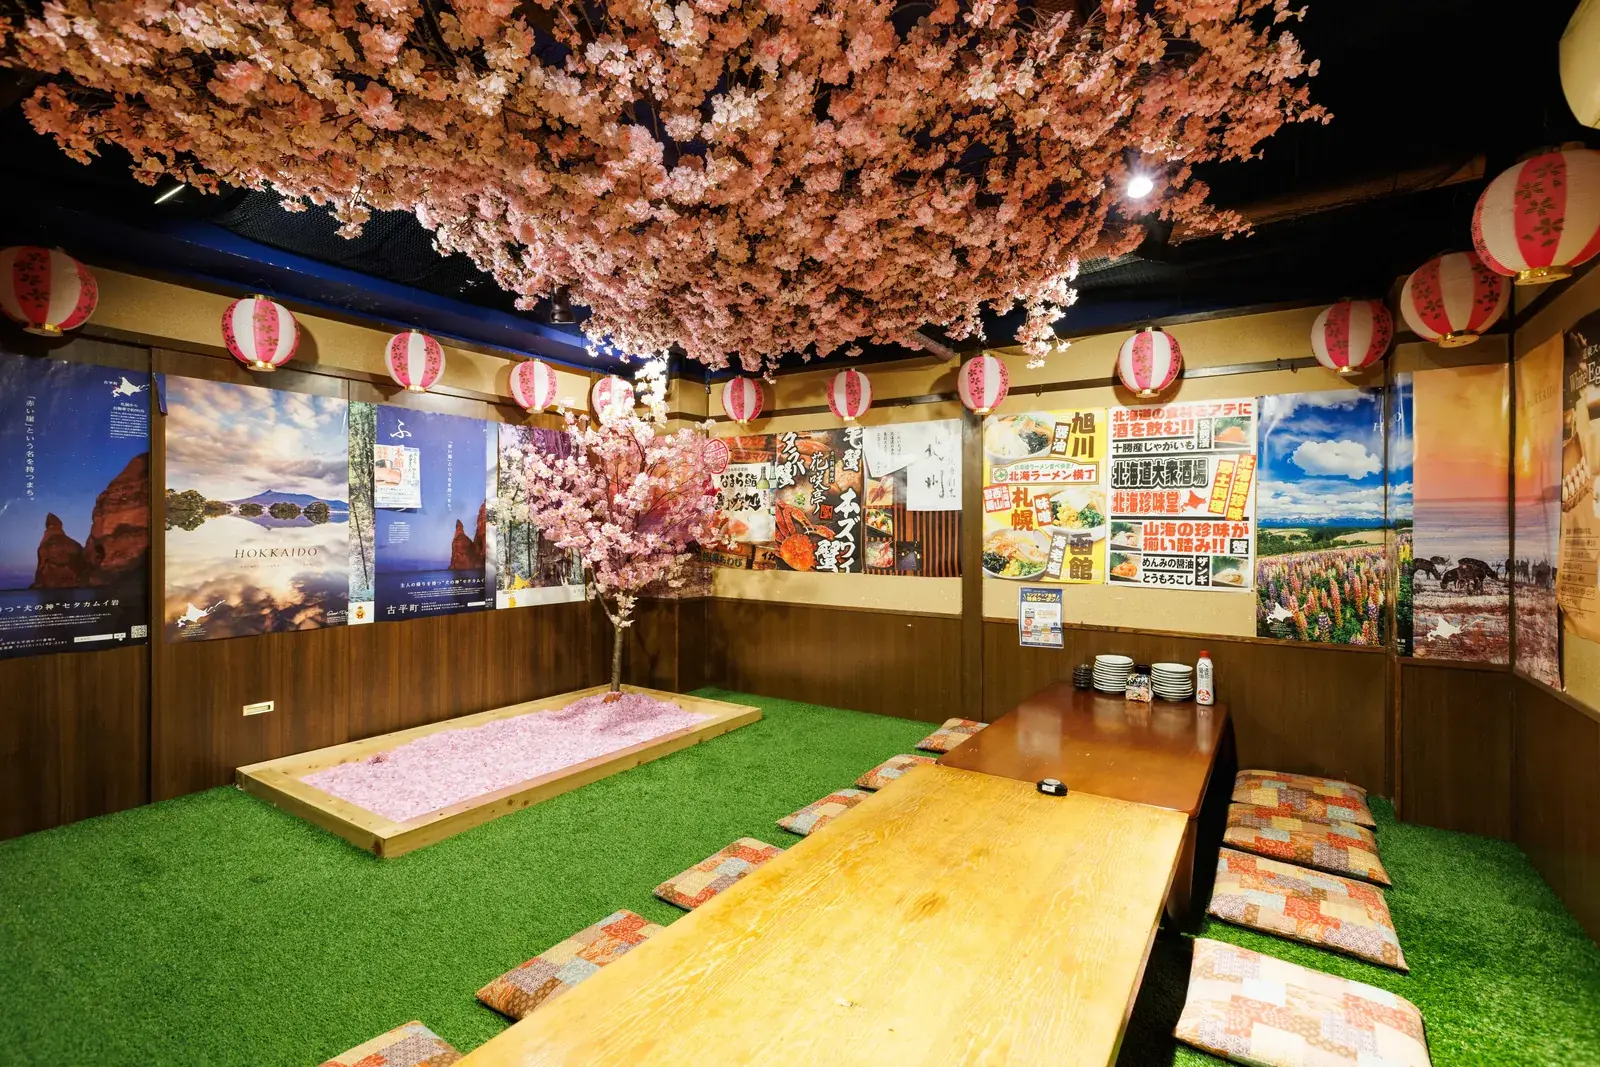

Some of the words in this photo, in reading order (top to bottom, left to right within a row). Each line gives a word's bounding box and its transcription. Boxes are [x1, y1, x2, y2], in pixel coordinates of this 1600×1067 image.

[1071, 412, 1096, 458] 旭川
[1113, 440, 1195, 453] 十勝産じゃがいも
[1009, 469, 1095, 481] 北海ラーメン横丁
[1112, 459, 1208, 487] 北海道大衆酒場
[1011, 487, 1034, 531] 札幌
[1112, 491, 1180, 514] 北海珍味堂
[1143, 522, 1249, 538] 山海の珍味が
[235, 548, 318, 559] HOKKAIDO
[1069, 533, 1093, 580] 函館
[1142, 558, 1194, 569] めんみの醤油
[1197, 556, 1208, 585] ザンギ
[1142, 573, 1193, 585] とうもろこし
[386, 604, 419, 615] 古平町
